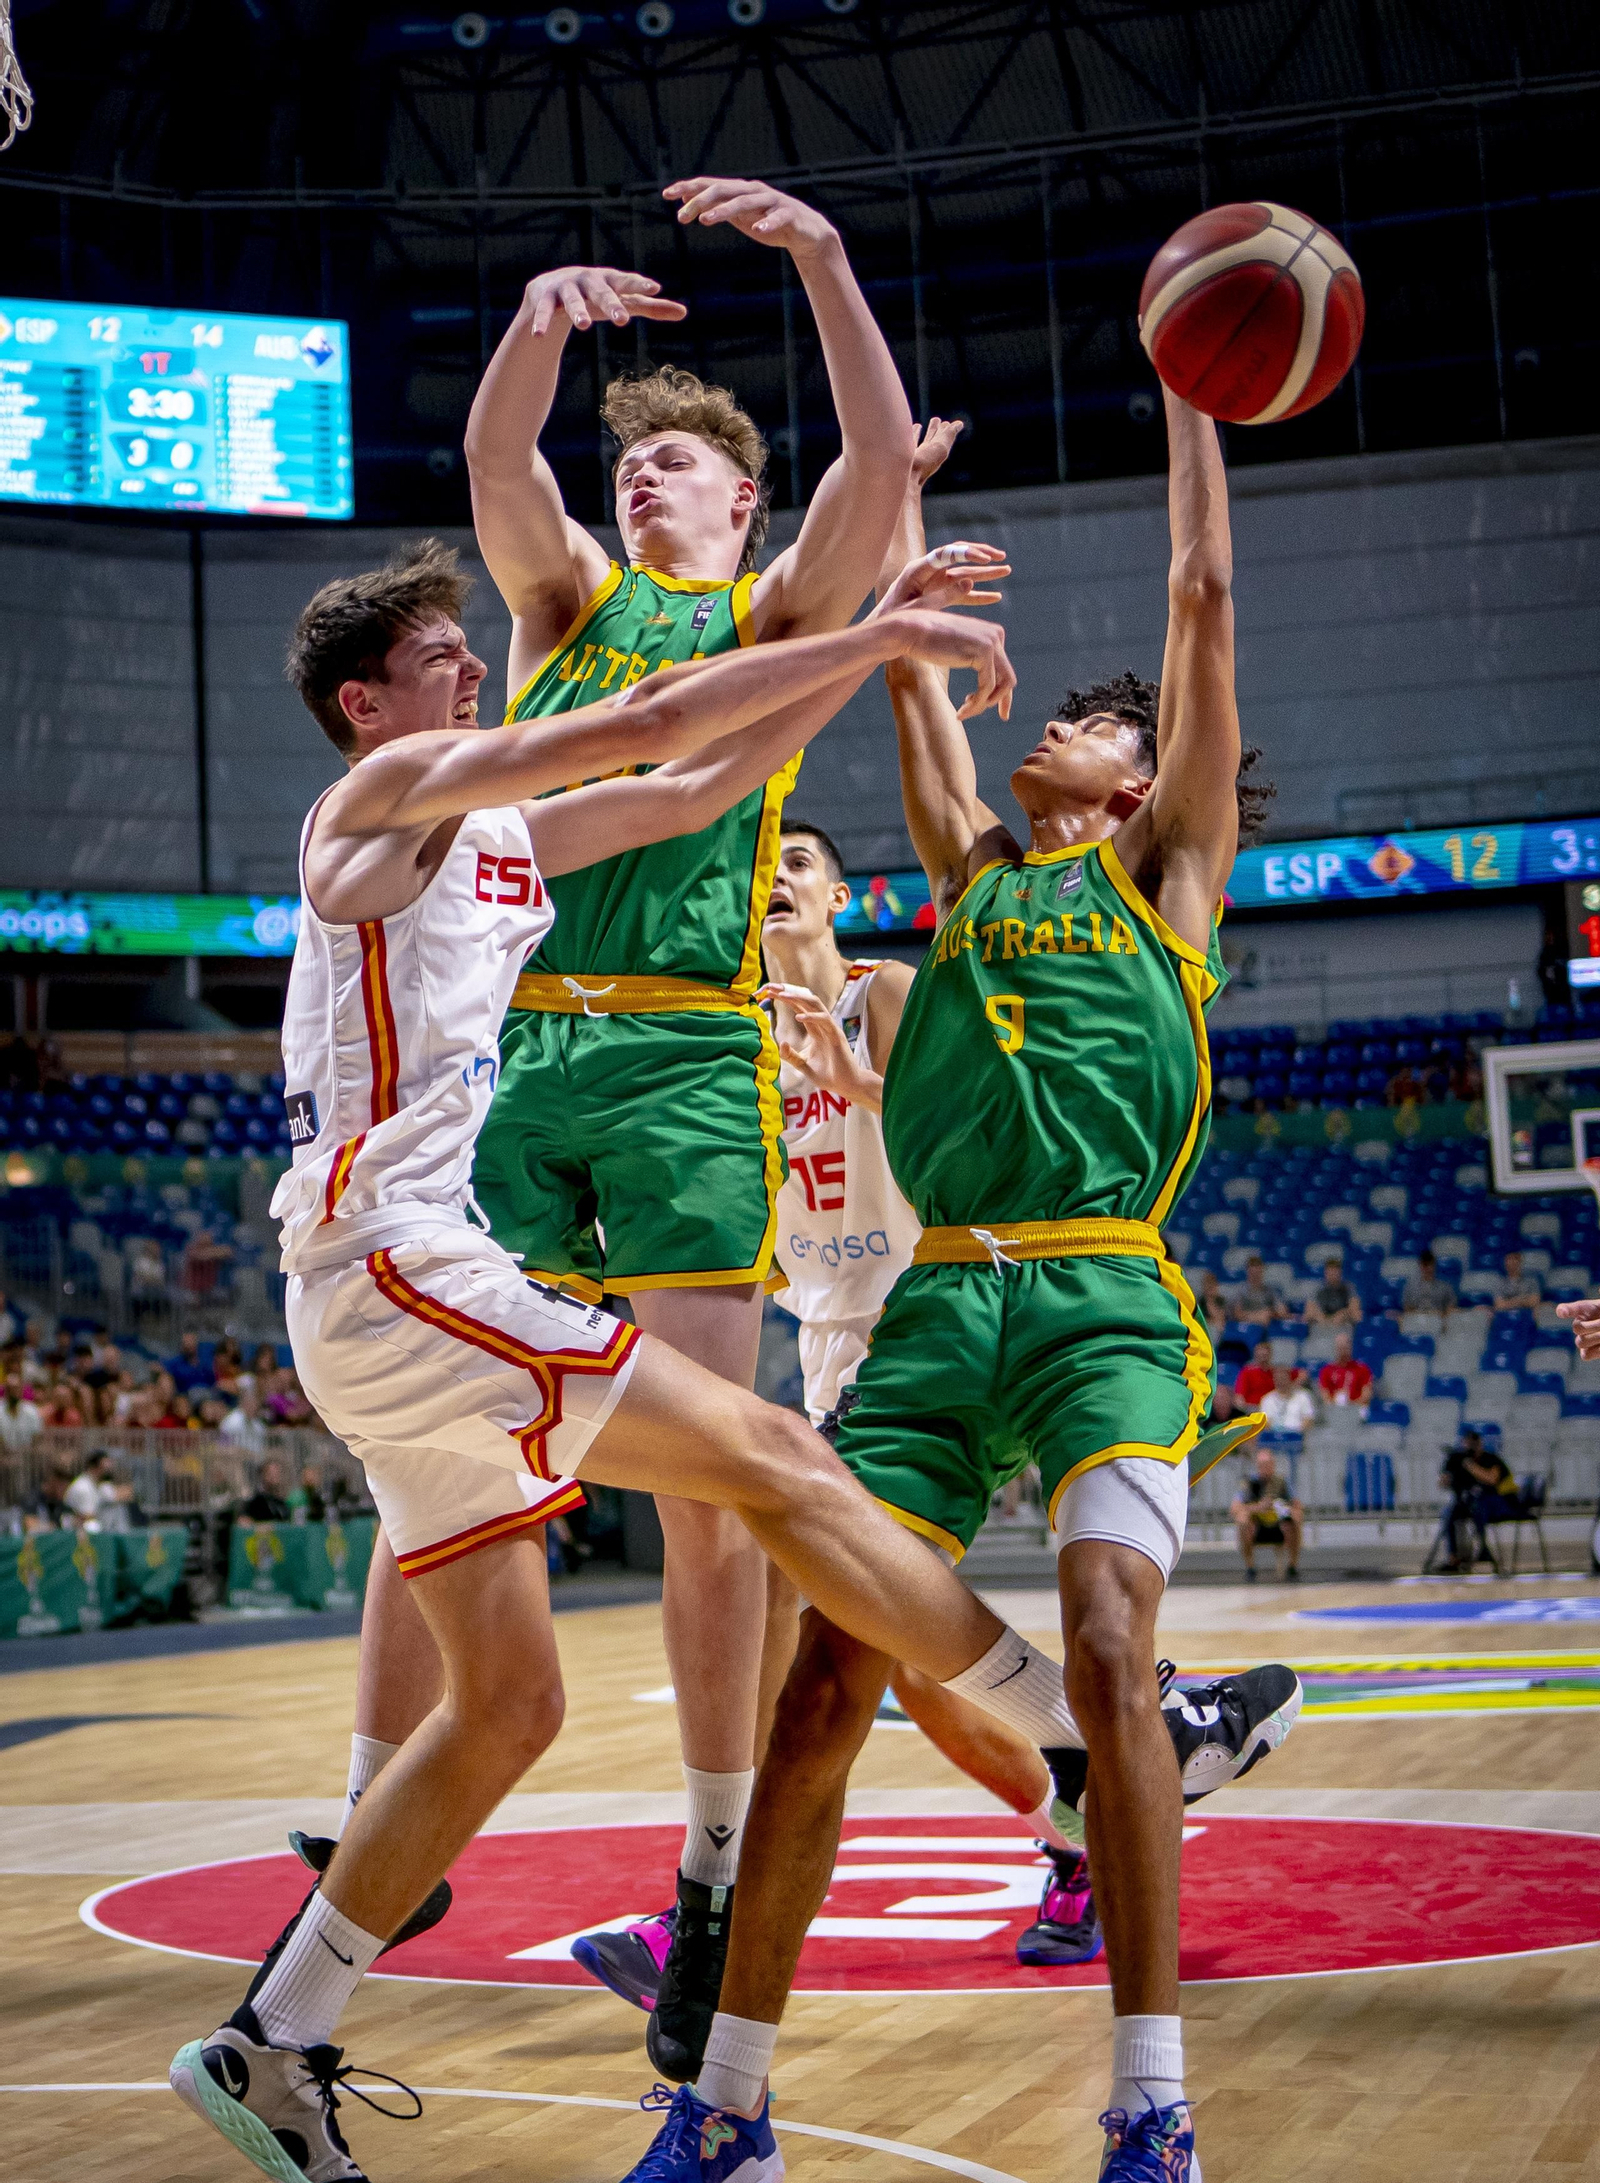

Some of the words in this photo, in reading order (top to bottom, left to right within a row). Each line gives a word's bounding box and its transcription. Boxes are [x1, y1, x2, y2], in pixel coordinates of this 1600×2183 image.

[88, 316, 121, 342] 12
[191, 323, 224, 347] 14
[1263, 853, 1343, 897] ESP
[1443, 832, 1501, 882] 12
[931, 912, 1140, 970] AUSTRALIA
[985, 994, 1026, 1056] 9
[788, 1151, 846, 1213] 15
